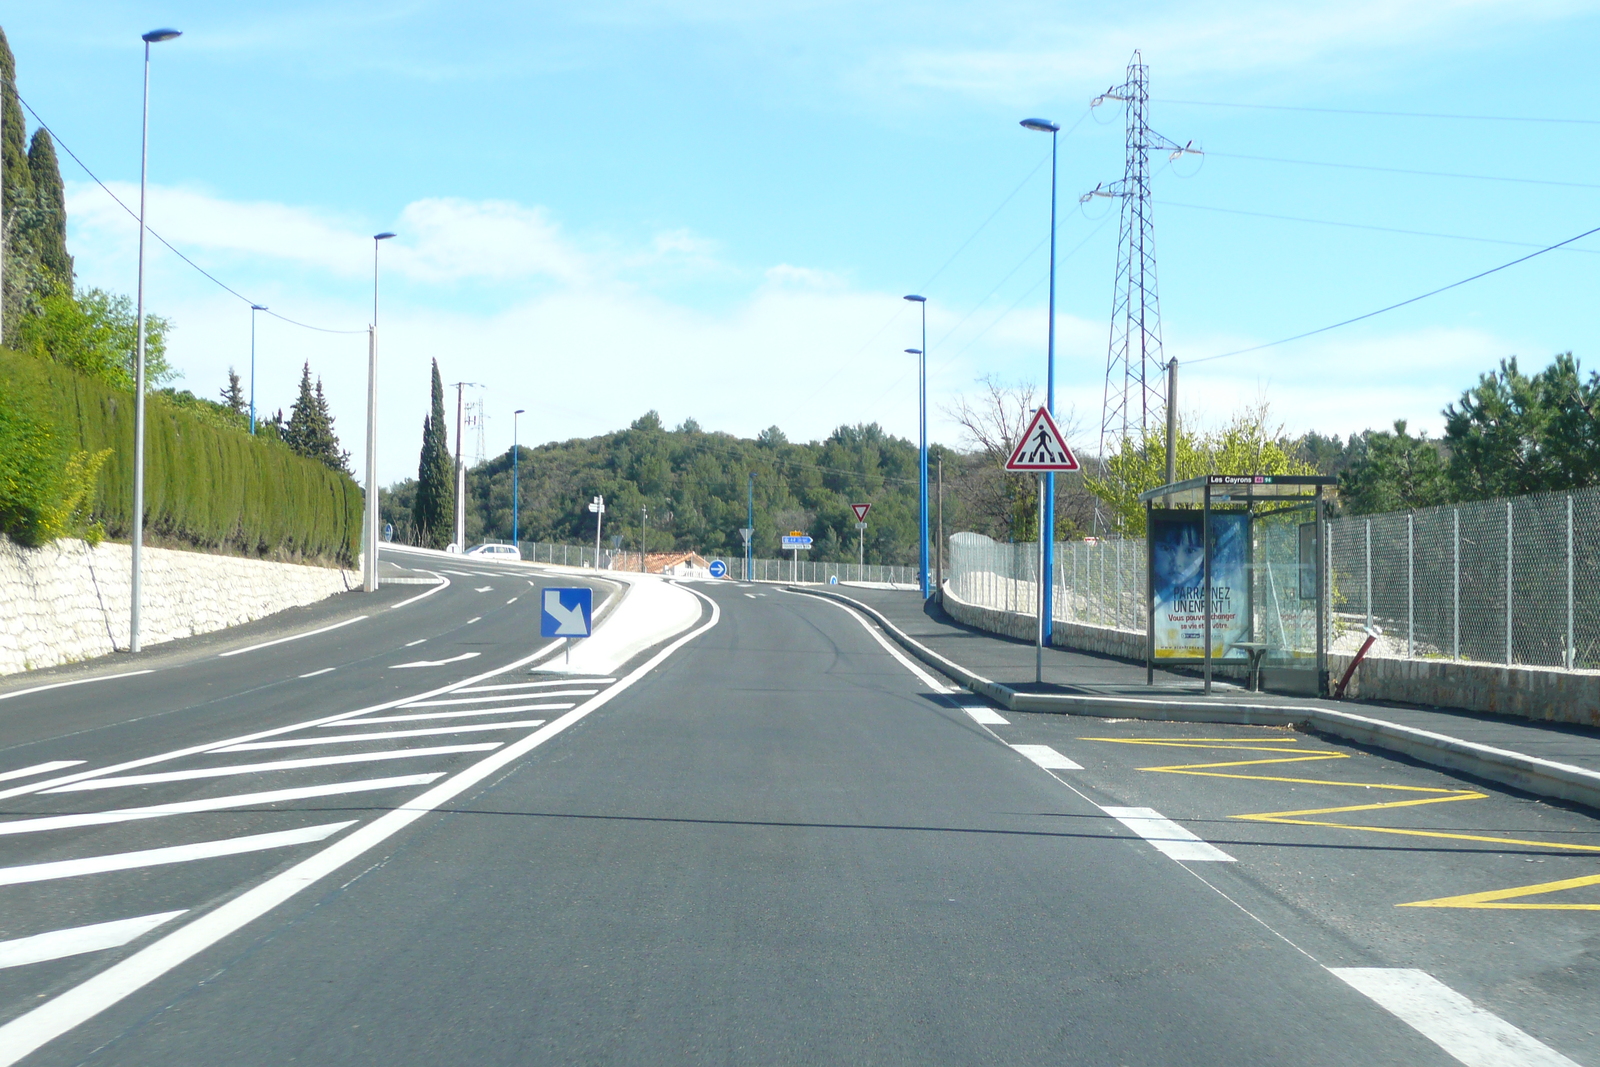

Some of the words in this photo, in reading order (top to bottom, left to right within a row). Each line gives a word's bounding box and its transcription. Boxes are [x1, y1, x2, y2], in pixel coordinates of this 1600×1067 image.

[1224, 476, 1252, 484] Cayrons
[1173, 586, 1231, 600] PARRANEZ
[1173, 600, 1187, 613] UN
[1188, 600, 1224, 613] ENFNT
[1210, 613, 1236, 621] changer
